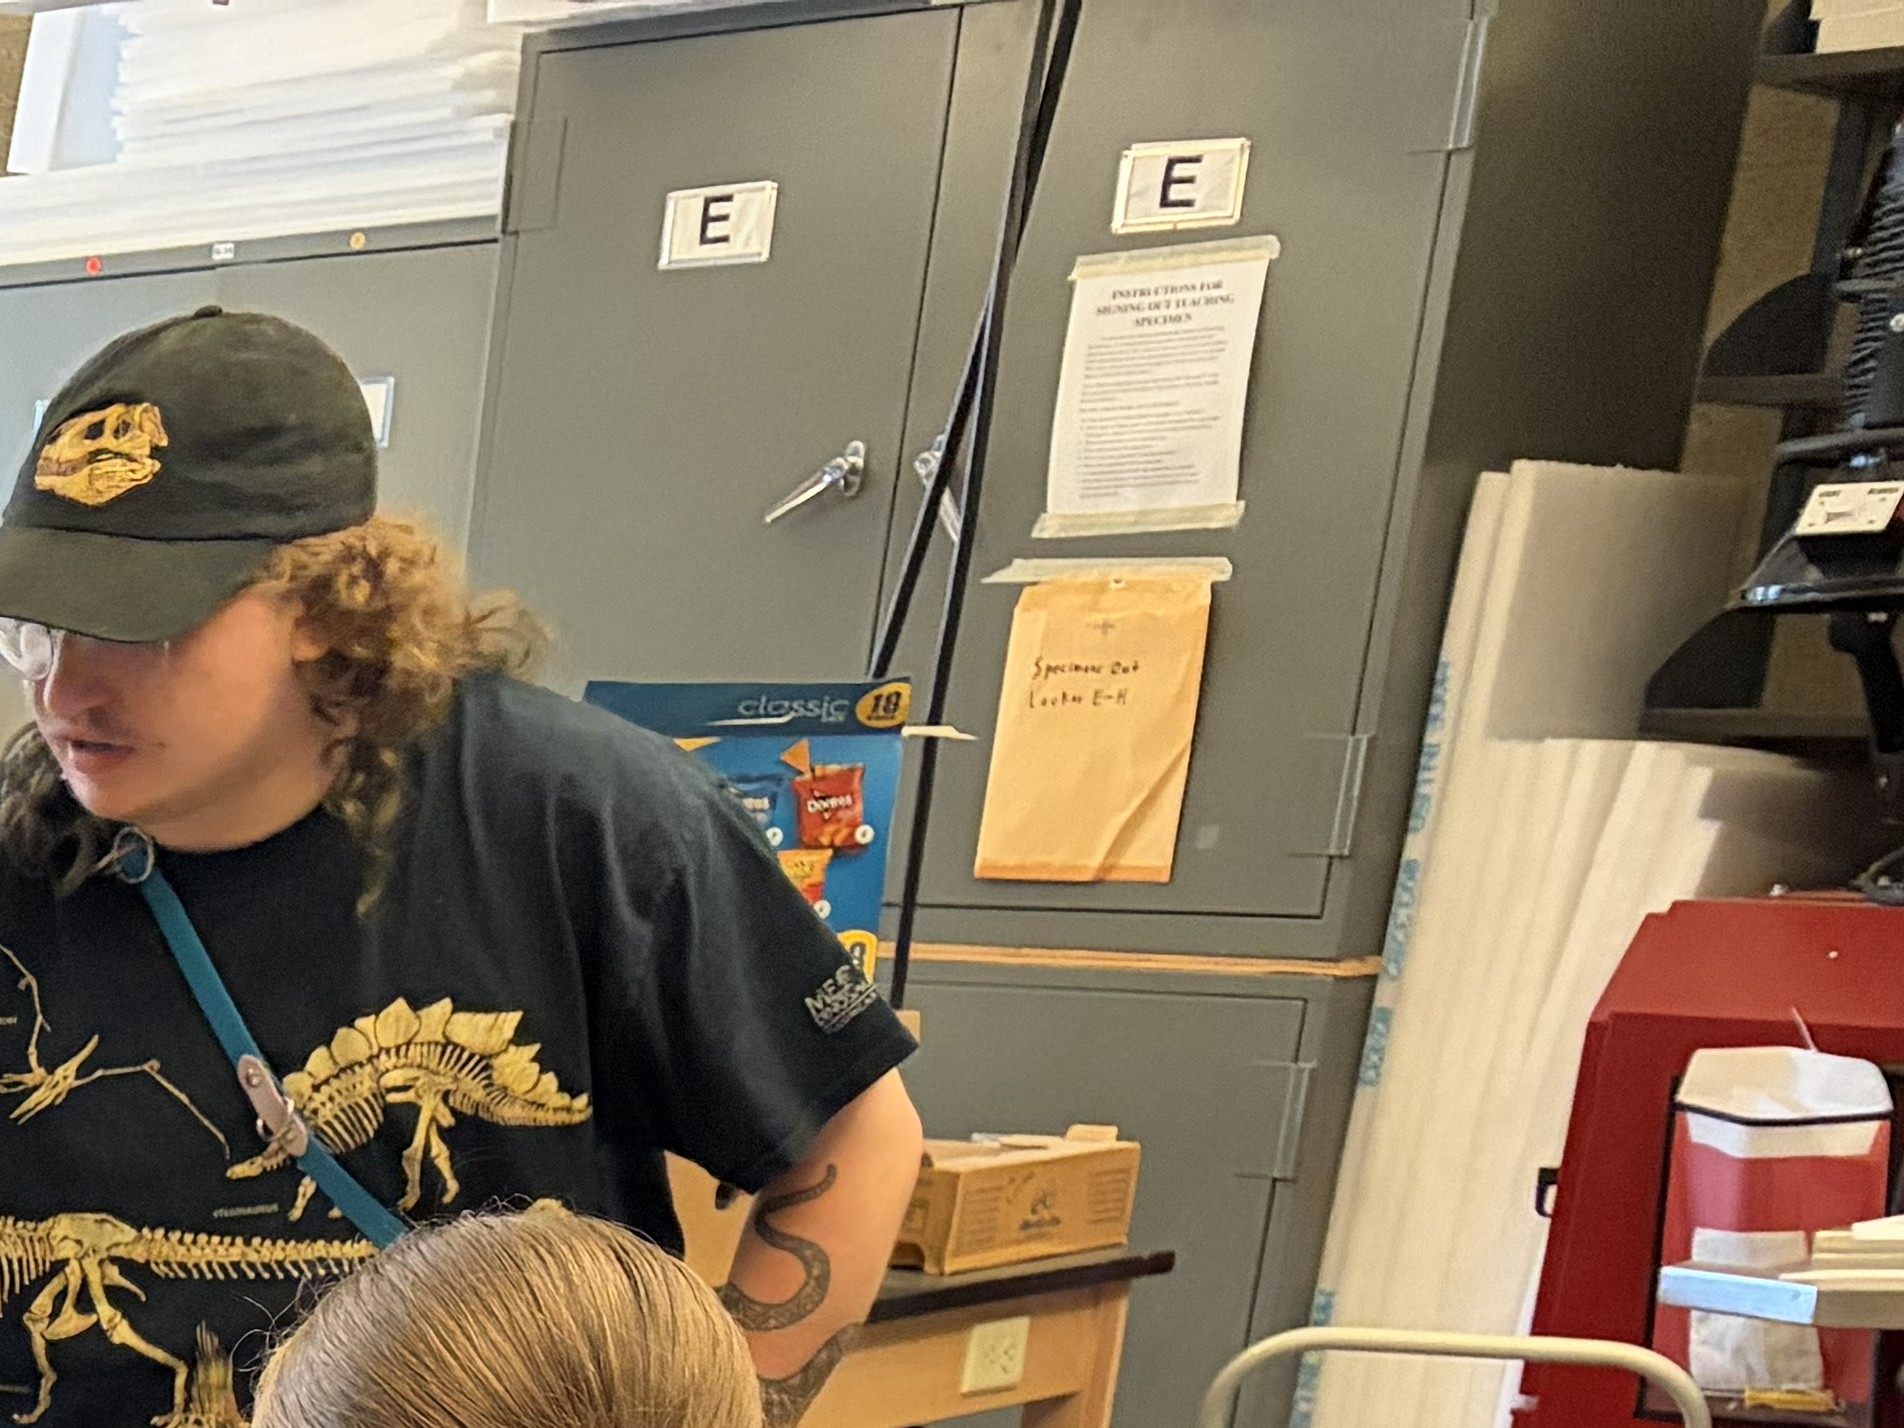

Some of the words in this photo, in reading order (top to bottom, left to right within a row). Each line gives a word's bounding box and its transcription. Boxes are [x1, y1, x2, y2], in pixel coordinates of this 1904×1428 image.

[1159, 154, 1203, 209] E
[699, 195, 734, 246] E
[1112, 283, 1197, 300] INSTRUCTIONS
[1200, 279, 1223, 292] FOR
[1147, 300, 1171, 312] OUT
[1175, 293, 1235, 309] TEACHING
[1133, 312, 1192, 328] SPECIMEN
